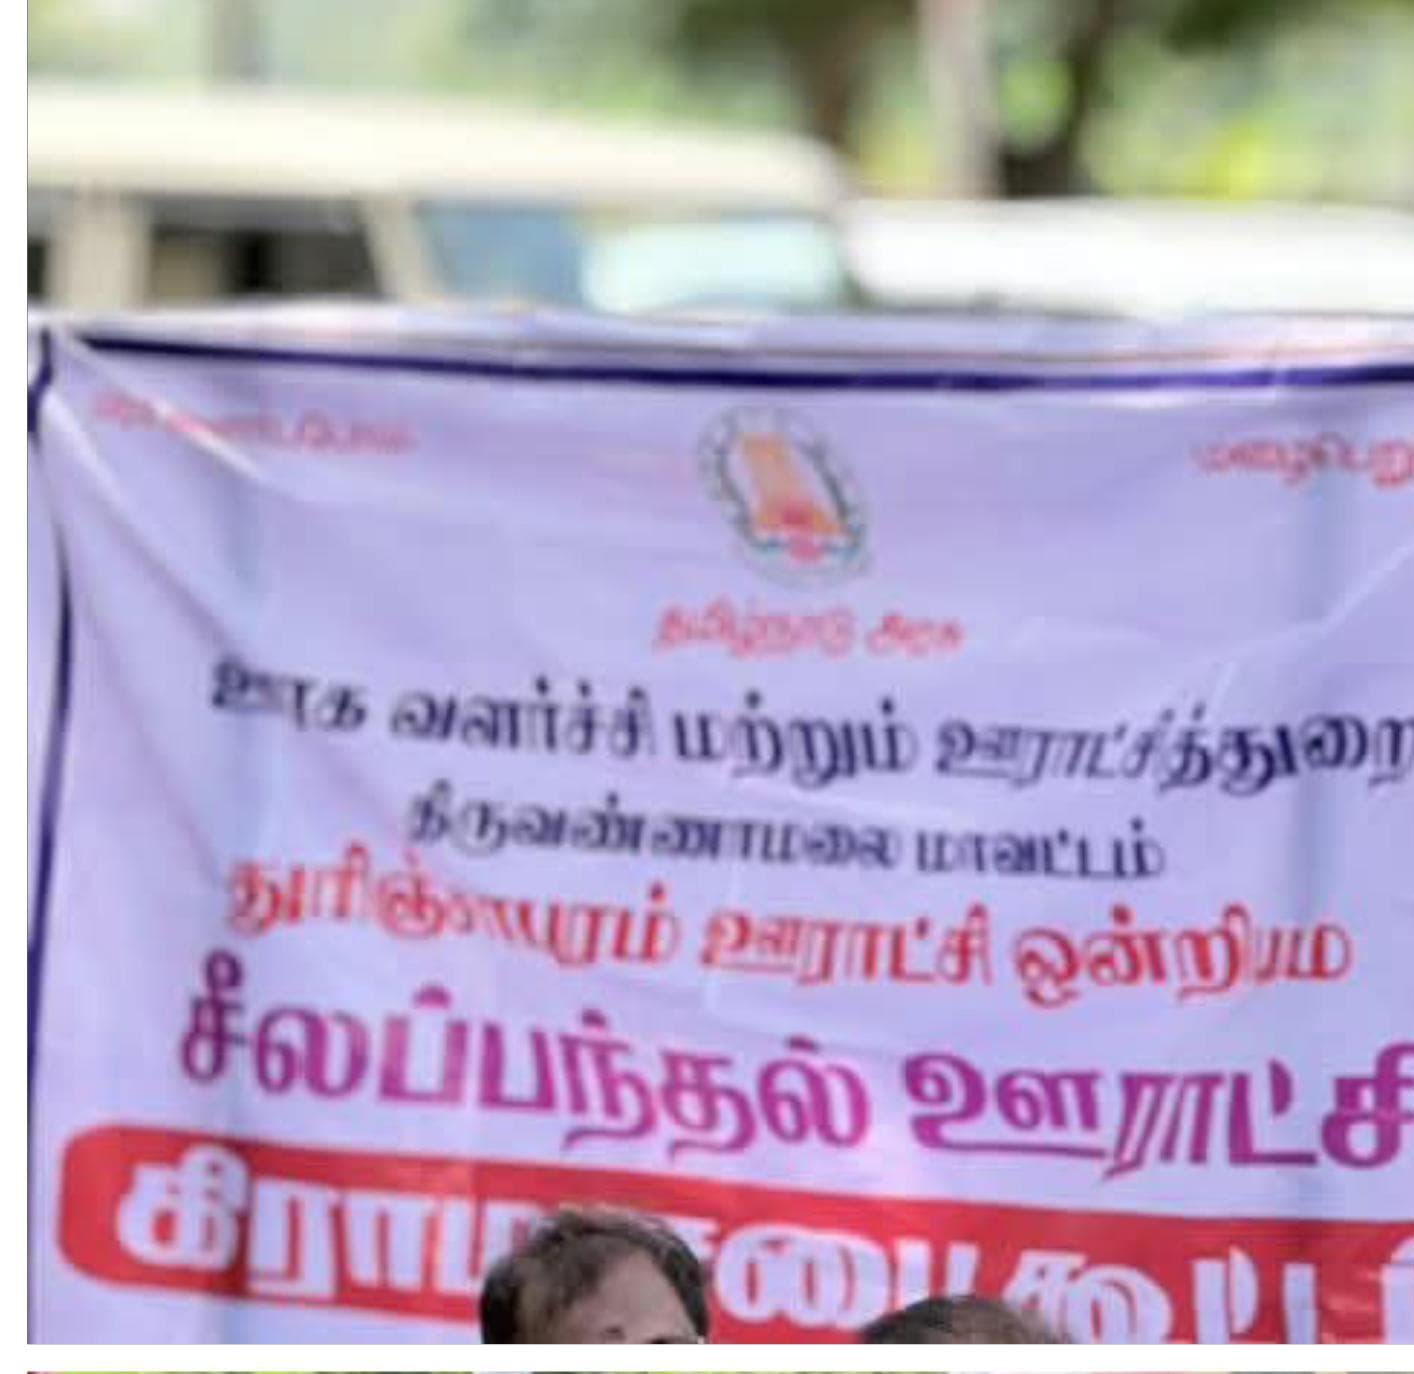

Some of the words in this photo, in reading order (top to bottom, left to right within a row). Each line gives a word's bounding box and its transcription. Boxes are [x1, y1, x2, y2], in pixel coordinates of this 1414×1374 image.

[390, 674, 656, 758] வளர்ச்சி
[673, 689, 919, 791] மற்றும்
[408, 777, 895, 868] திருவண்ணாமலை
[915, 816, 1166, 880] மாவட்டம்
[700, 902, 993, 986] ஊராட்சி
[180, 949, 873, 1158] சீலப்பந்தல்
